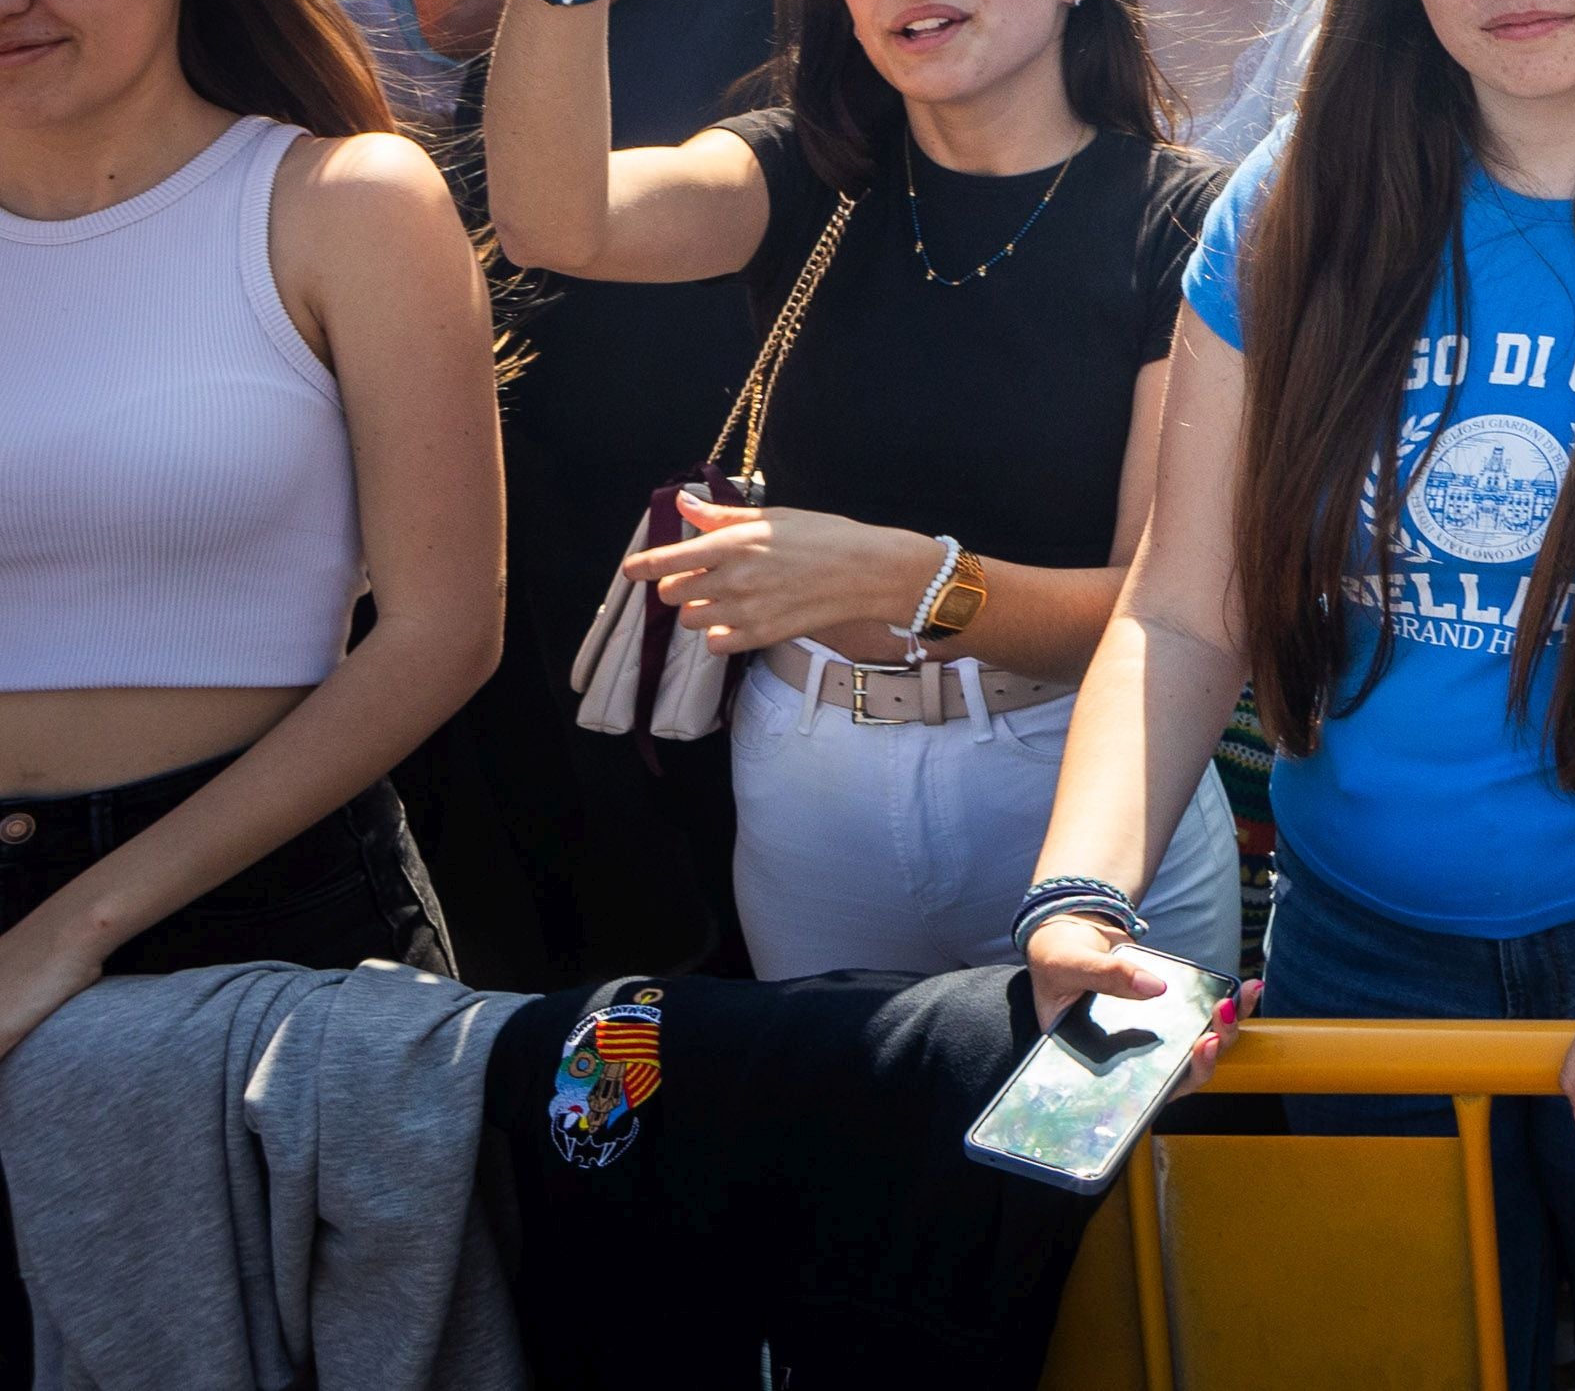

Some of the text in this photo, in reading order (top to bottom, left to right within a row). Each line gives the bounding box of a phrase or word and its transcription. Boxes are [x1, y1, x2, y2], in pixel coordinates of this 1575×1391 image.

[1402, 333, 1469, 391] GO
[1488, 332, 1556, 388] DI
[1488, 418, 1544, 442] GIARDINI
[1381, 616, 1484, 651] GRAND
